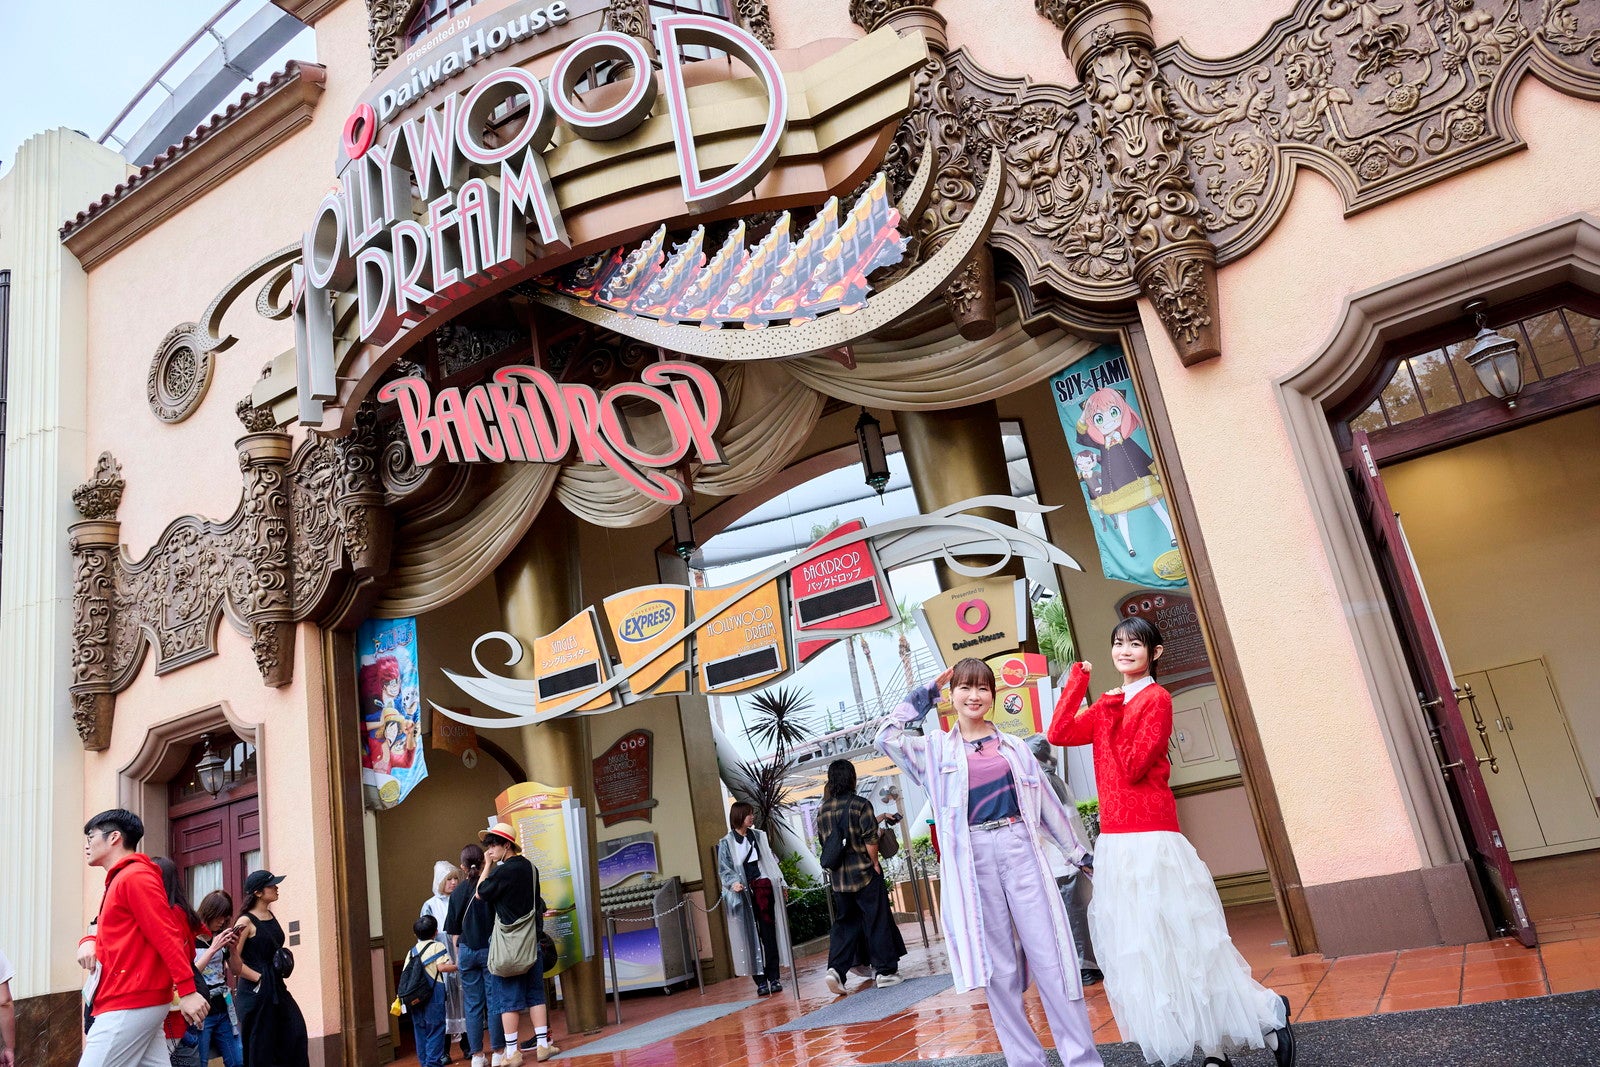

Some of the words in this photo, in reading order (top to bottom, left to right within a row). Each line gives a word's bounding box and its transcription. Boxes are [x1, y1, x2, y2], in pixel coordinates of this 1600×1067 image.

[406, 24, 455, 65] Presented
[457, 15, 471, 31] by
[355, 145, 558, 343] DREAM
[377, 361, 724, 505] BACKDROP
[803, 551, 861, 581] BACKDROP
[807, 567, 862, 592] バックドロップ
[951, 588, 978, 600] Presented
[625, 607, 671, 638] EXPRESS
[706, 605, 774, 637] HOLLYWOOD
[744, 621, 777, 642] DREAM
